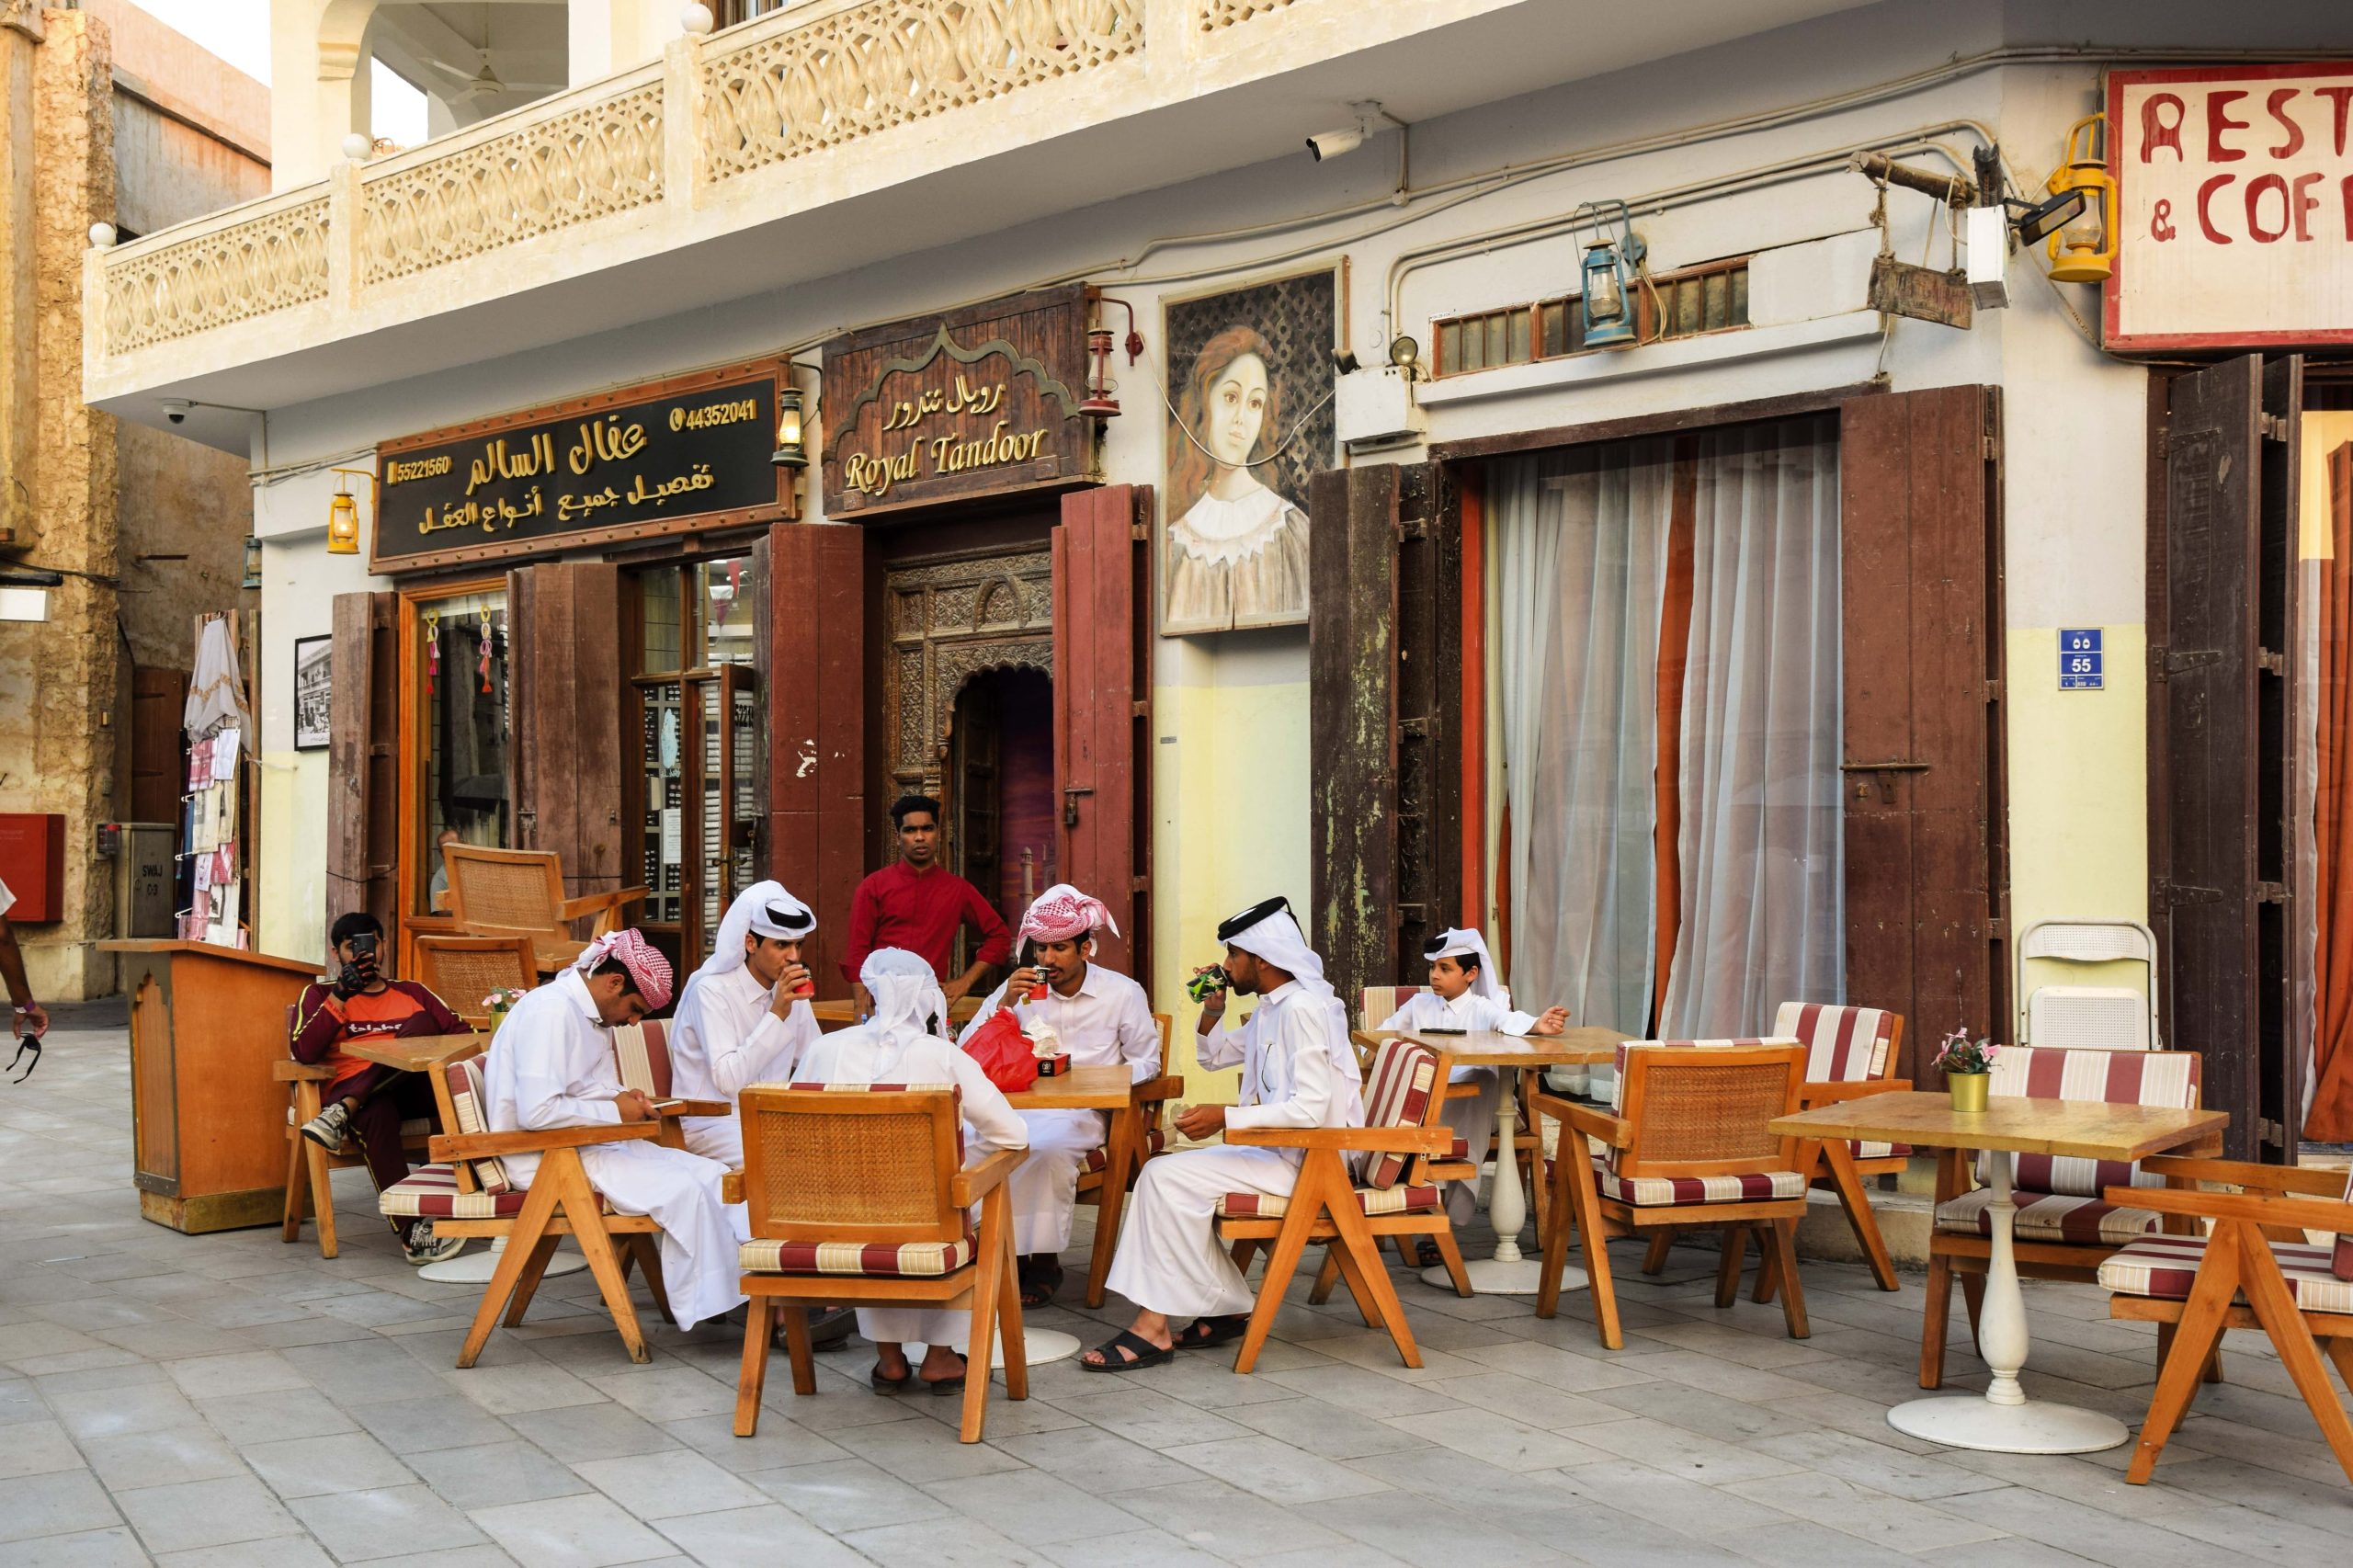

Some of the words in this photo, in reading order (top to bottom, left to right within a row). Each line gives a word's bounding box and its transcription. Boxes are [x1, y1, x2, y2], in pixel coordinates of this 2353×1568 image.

[2151, 199, 2176, 242] &
[686, 399, 756, 430] 44352041
[947, 374, 1006, 415] رويال
[465, 432, 555, 496] السالم
[569, 415, 647, 475] عقال
[845, 436, 926, 496] Royal
[930, 420, 1049, 473] Tandoor
[397, 455, 453, 482] 55221560
[627, 464, 714, 506] تفصيل
[418, 502, 478, 535] العقل
[483, 485, 542, 532] أنواع
[558, 486, 620, 521] جميع
[2072, 658, 2091, 673] 55
